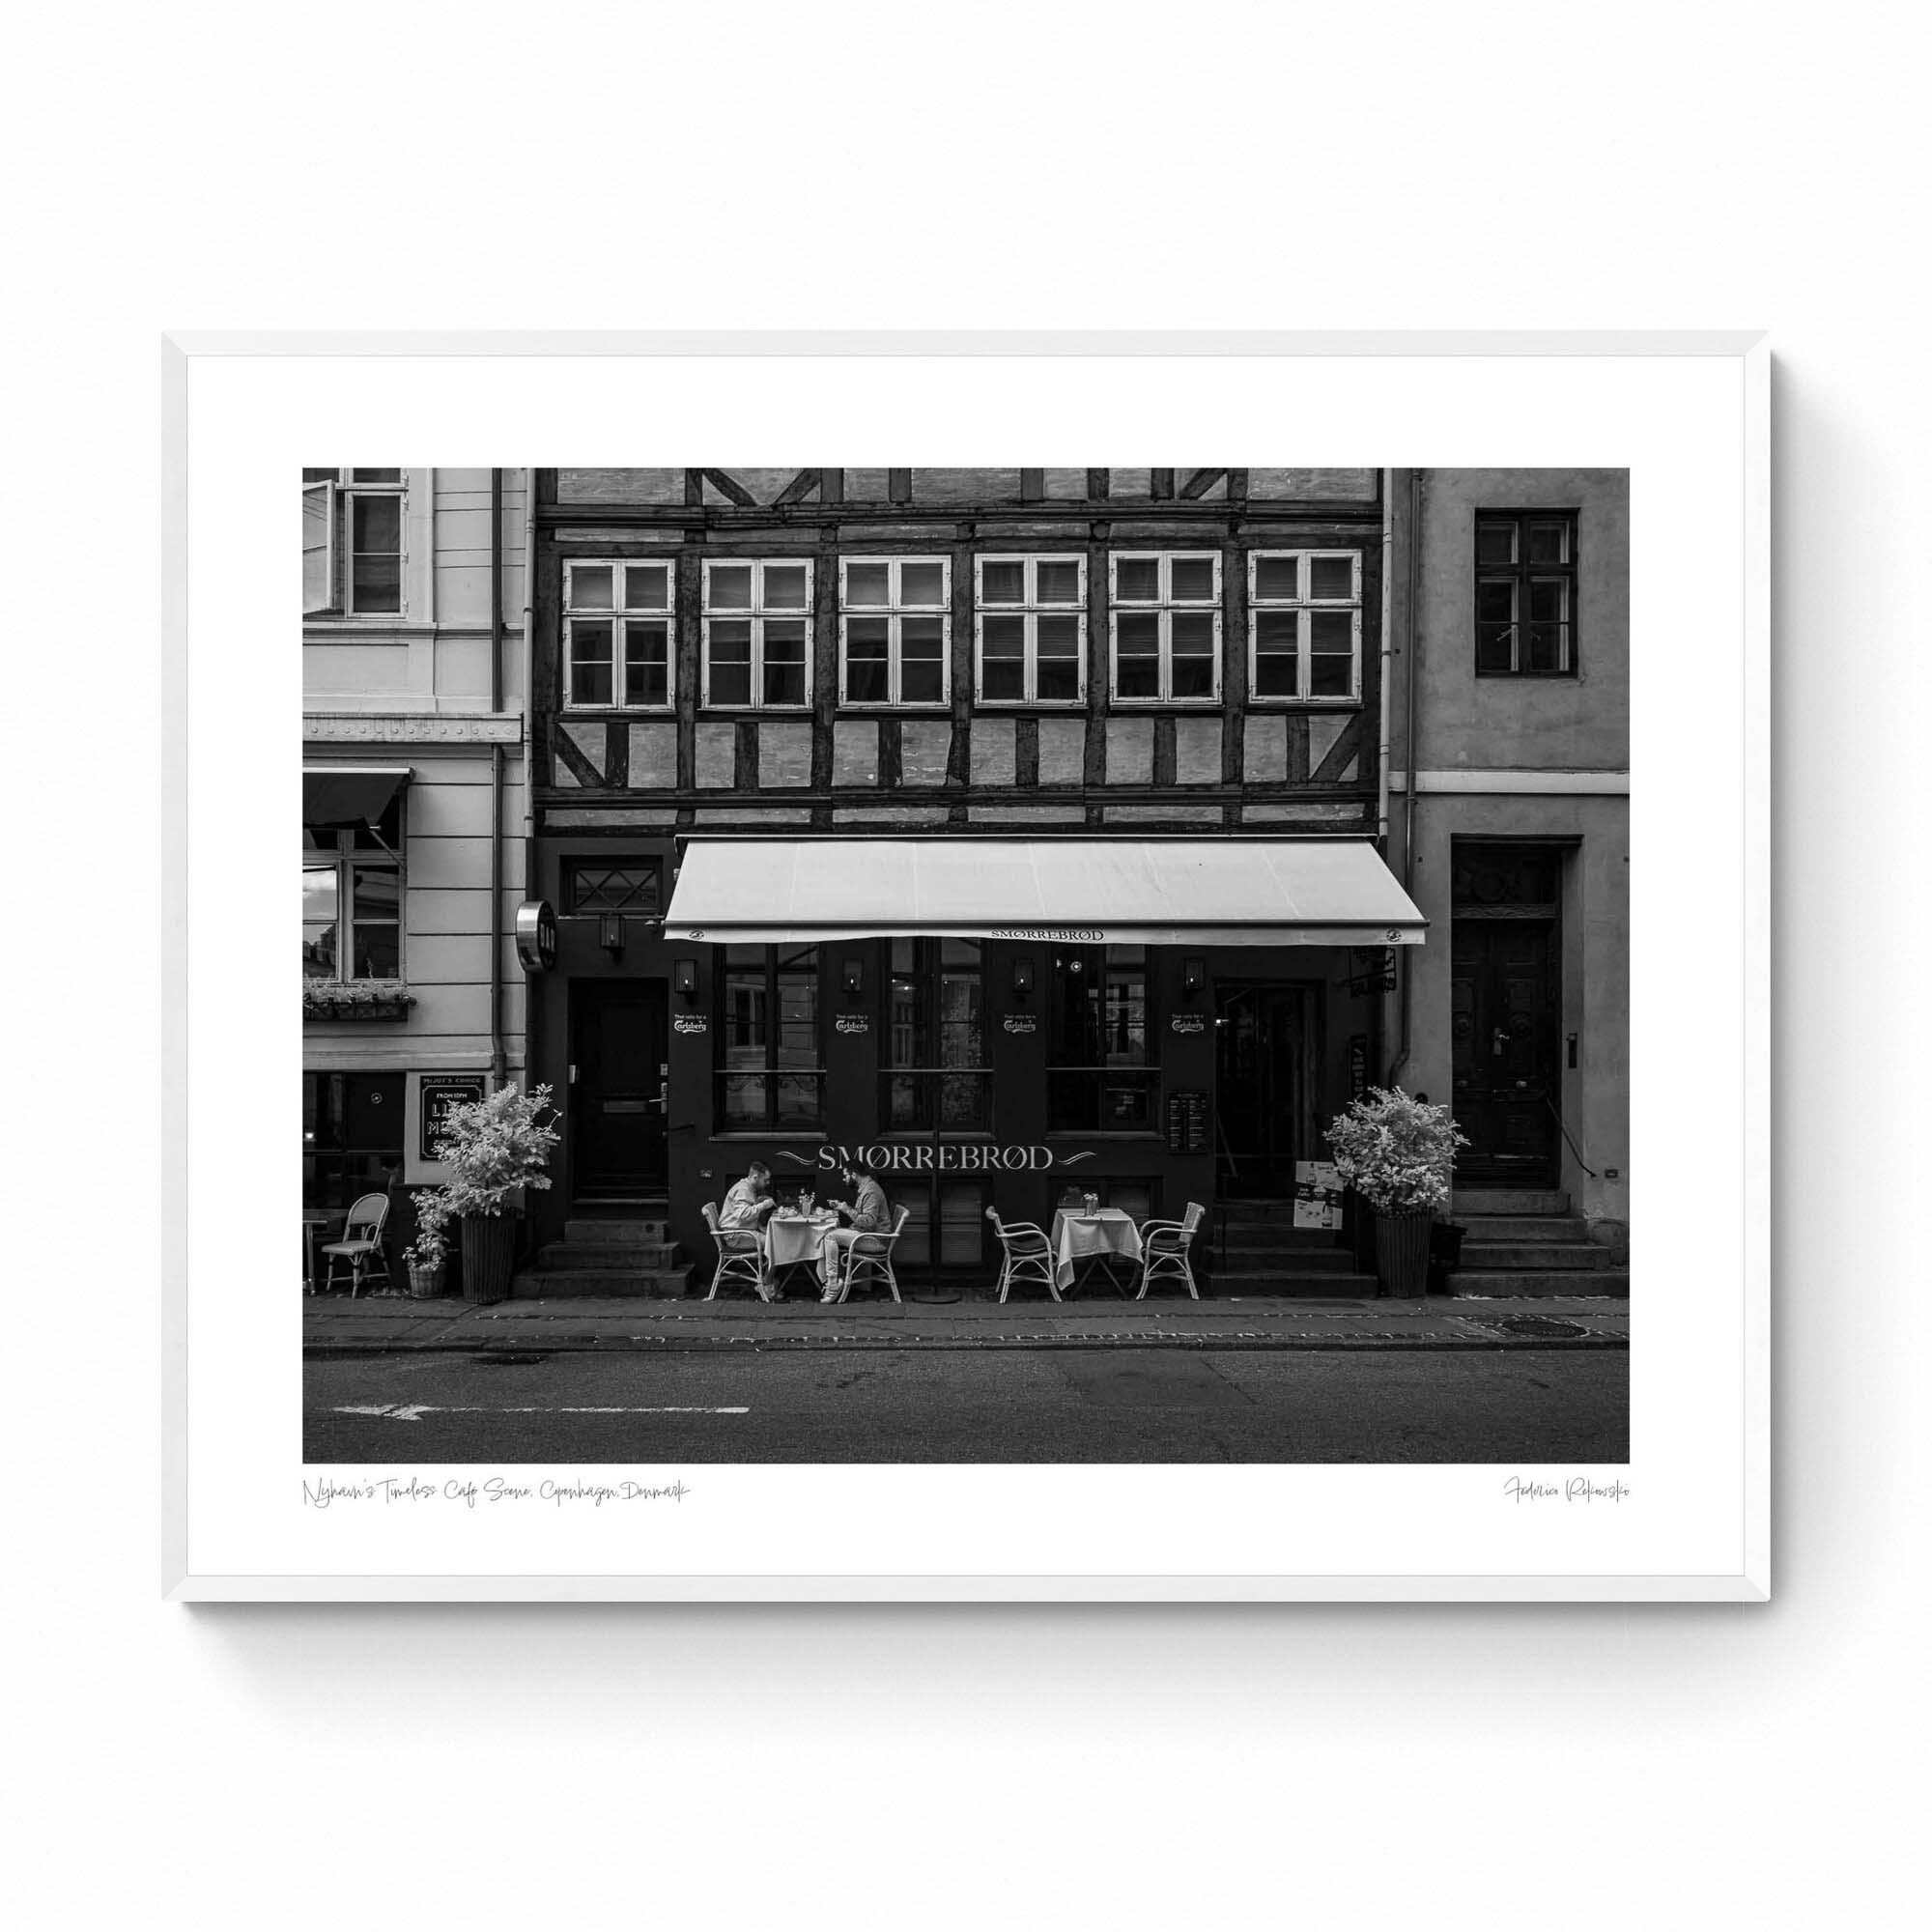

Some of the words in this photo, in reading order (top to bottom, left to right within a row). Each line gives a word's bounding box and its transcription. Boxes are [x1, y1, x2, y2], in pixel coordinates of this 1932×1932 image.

[991, 929, 1104, 941] SMØRREBRØD
[674, 1020, 707, 1034] Carlsberg
[836, 1020, 868, 1034] Carlsberg
[1004, 1020, 1036, 1034] Carlsberg
[1171, 1020, 1205, 1034] Carlsberg
[818, 1145, 1053, 1170] SMØRREBRØD
